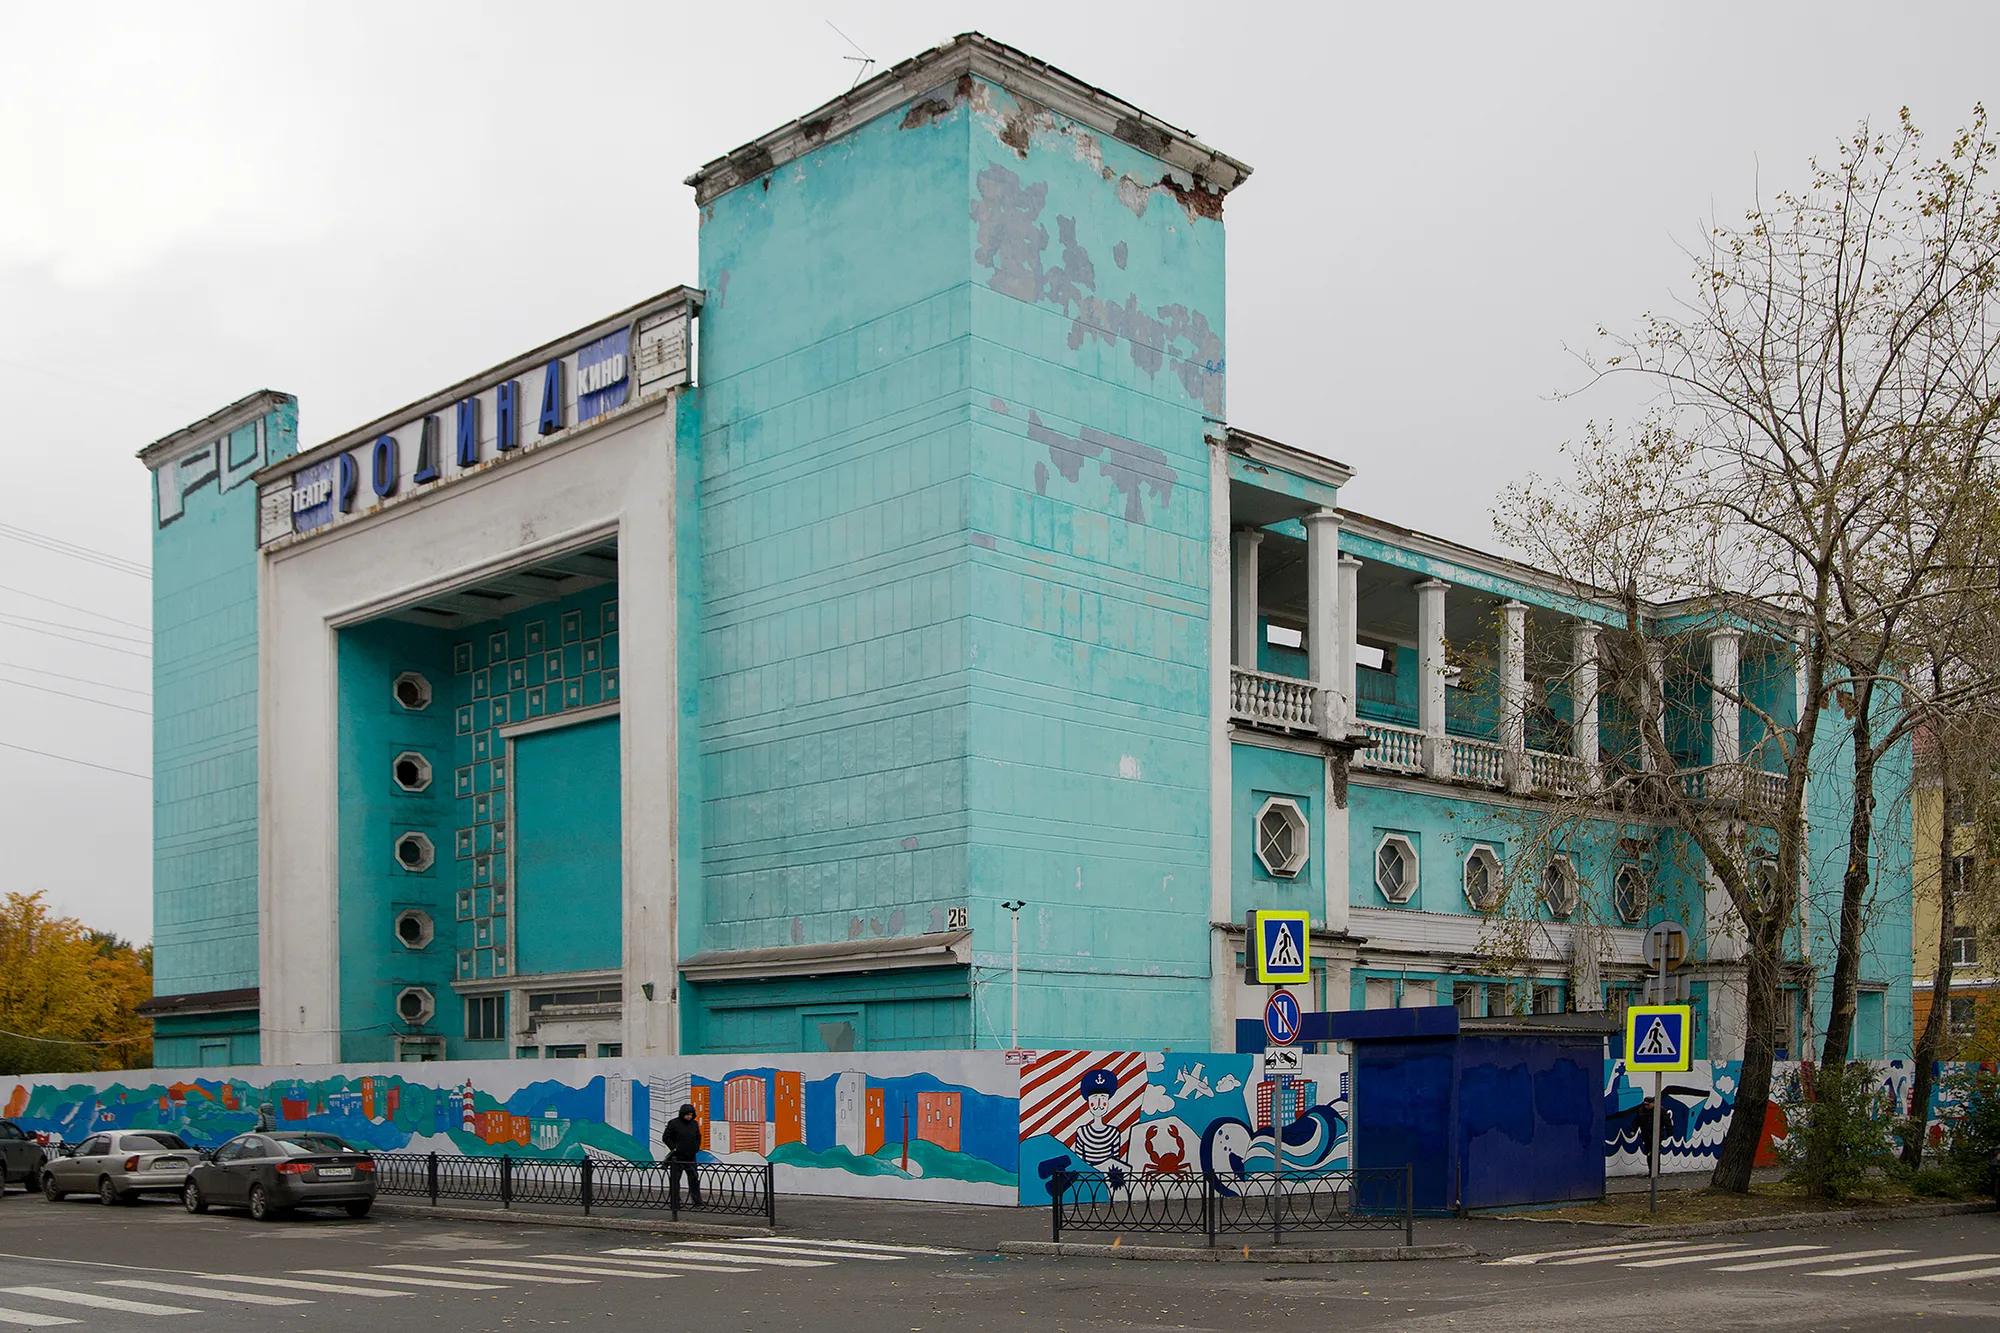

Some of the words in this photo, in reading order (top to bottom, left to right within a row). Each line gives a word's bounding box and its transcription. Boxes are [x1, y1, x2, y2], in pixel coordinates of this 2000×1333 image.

[292, 480, 331, 512] ТЕАТР
[339, 358, 565, 513] РОДИНА
[577, 353, 628, 396] КИНО
[948, 907, 967, 928] 26
